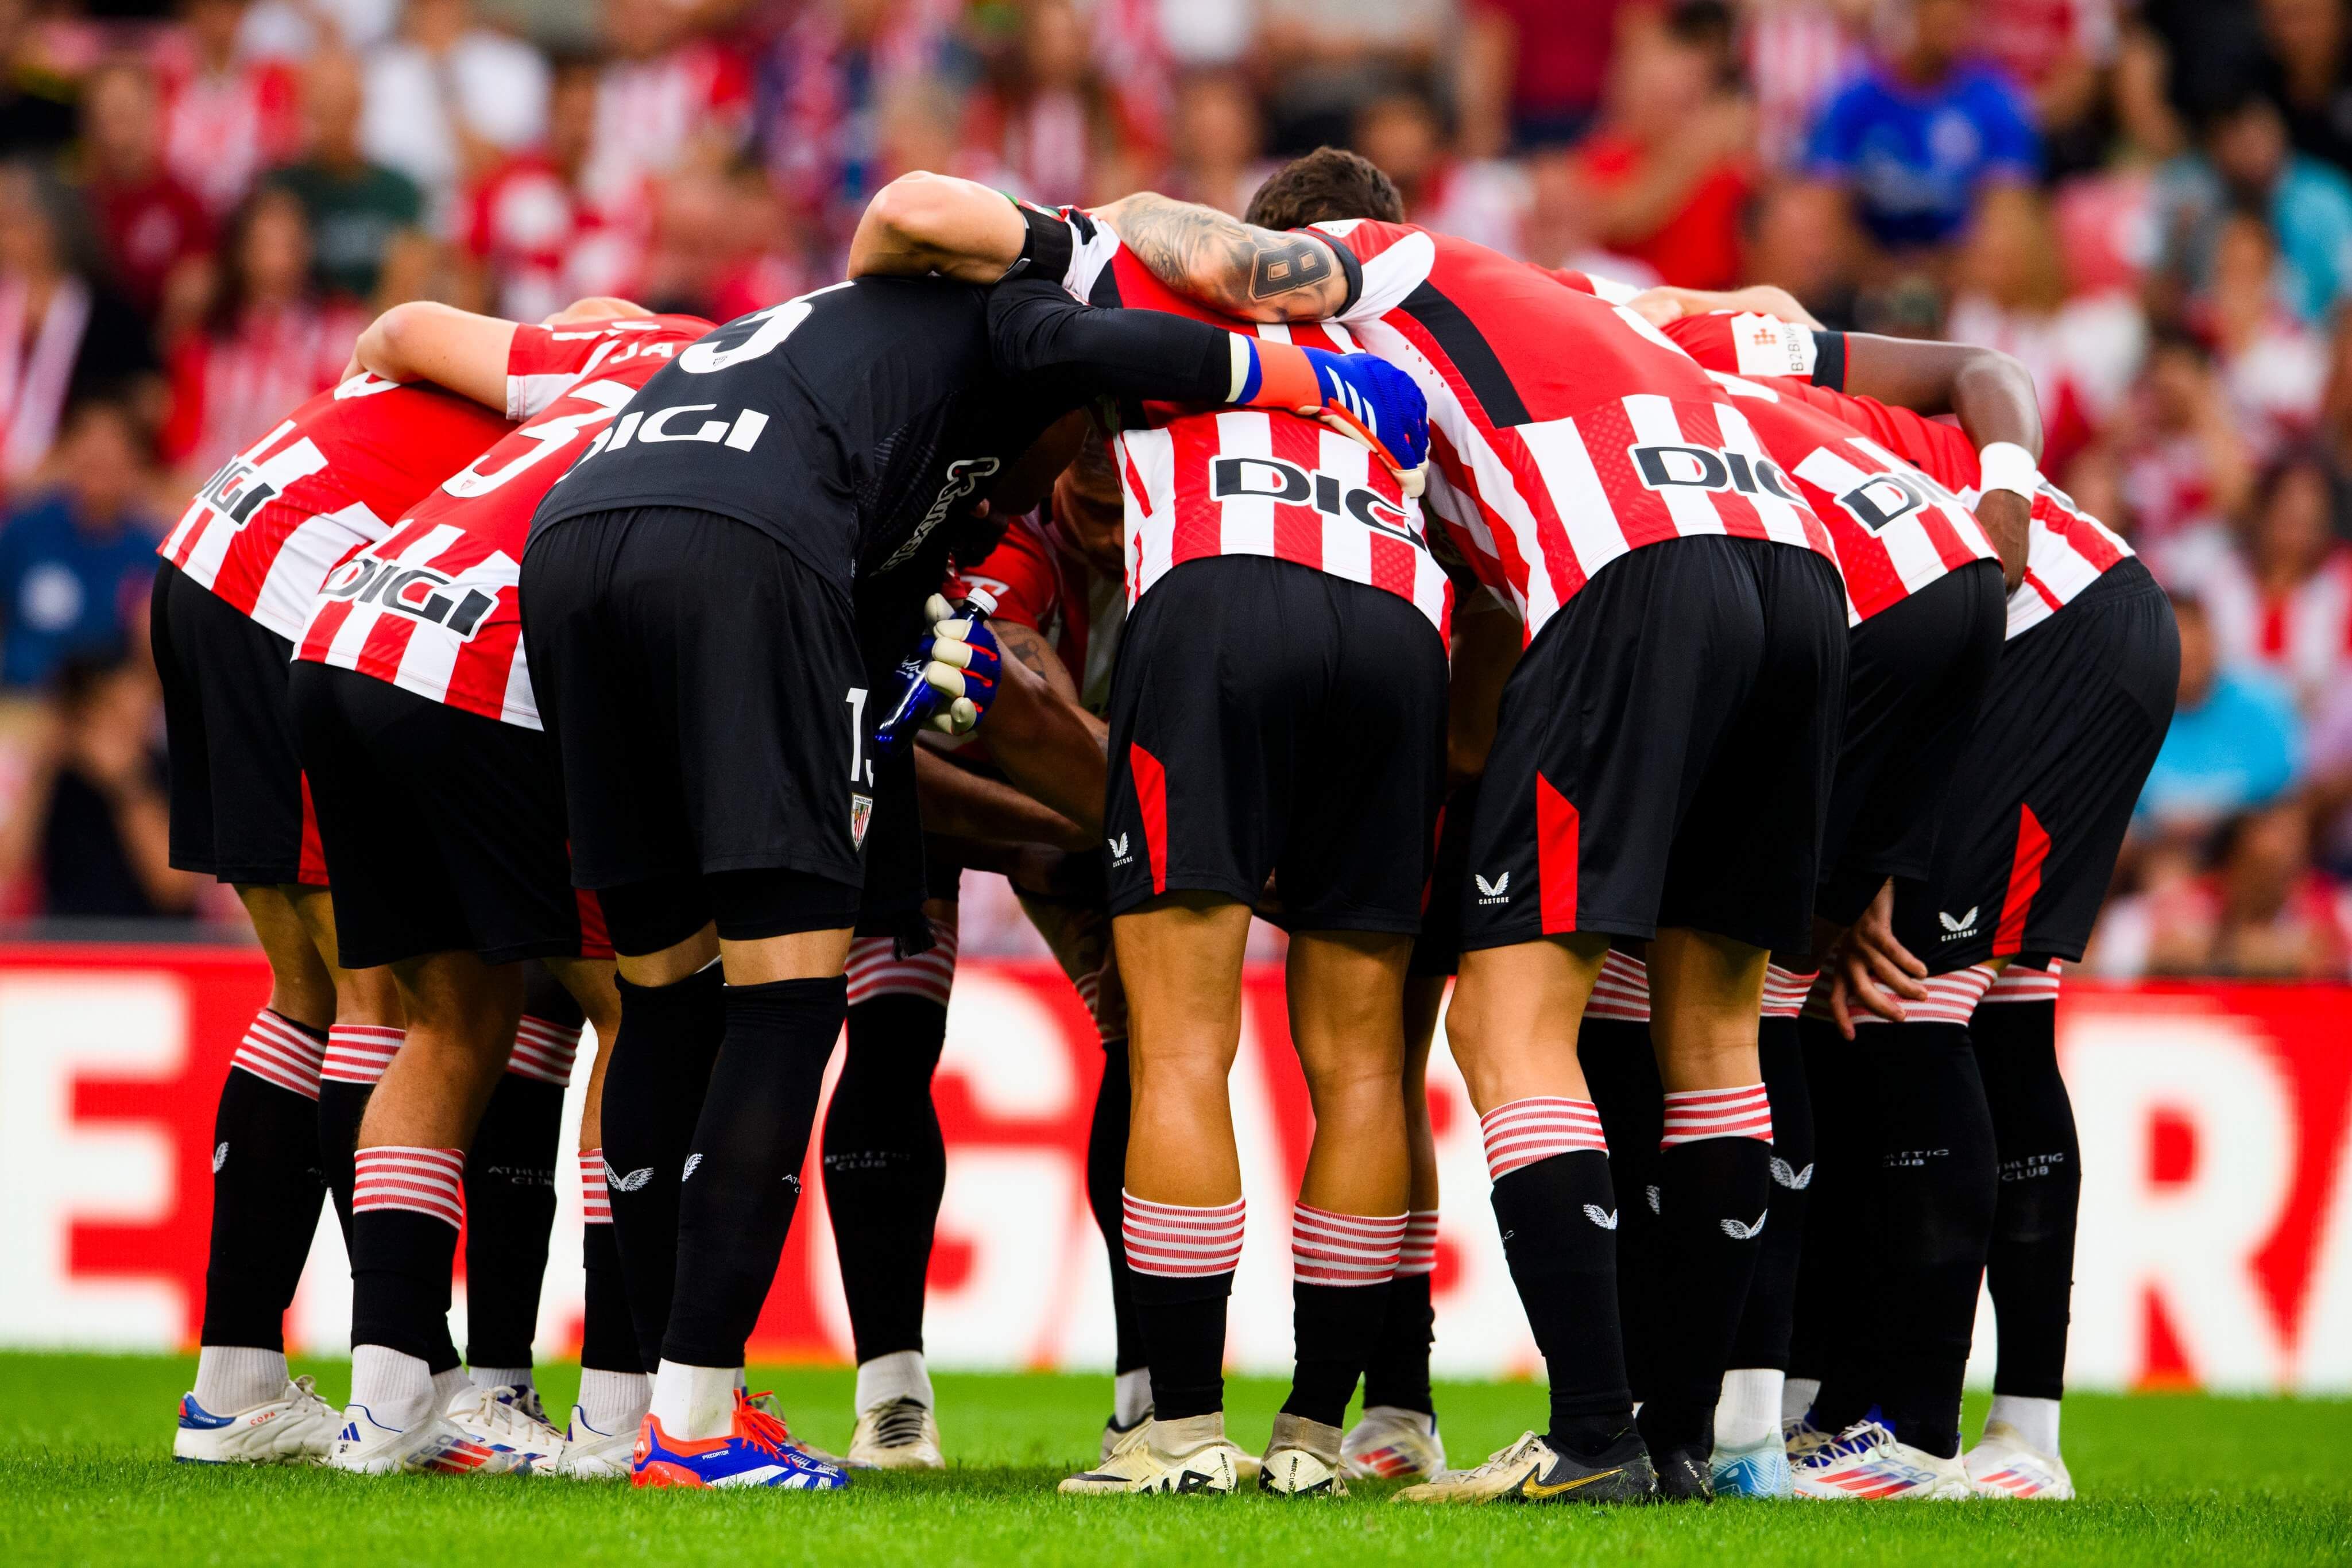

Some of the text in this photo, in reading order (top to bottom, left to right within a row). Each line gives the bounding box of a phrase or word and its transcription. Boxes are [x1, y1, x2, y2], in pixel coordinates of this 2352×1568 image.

[1634, 447, 1811, 508] DI
[195, 457, 276, 525] IGI
[1216, 458, 1428, 552] DIG
[1841, 473, 1959, 531] DI
[320, 559, 494, 636] DIGI
[1479, 896, 1510, 905] CASTORE
[1941, 928, 1978, 942] CASTORE
[1883, 1148, 1949, 1160] HLETIC
[488, 1166, 555, 1177] ATHLE
[835, 1159, 887, 1171] CLUB
[1997, 1152, 2064, 1176] HLETIC
[2002, 1166, 2049, 1182] CLUB
[250, 1410, 276, 1427] COPA
[702, 1450, 729, 1460] PREDATOR
[1287, 1456, 1299, 1493] MERCURI
